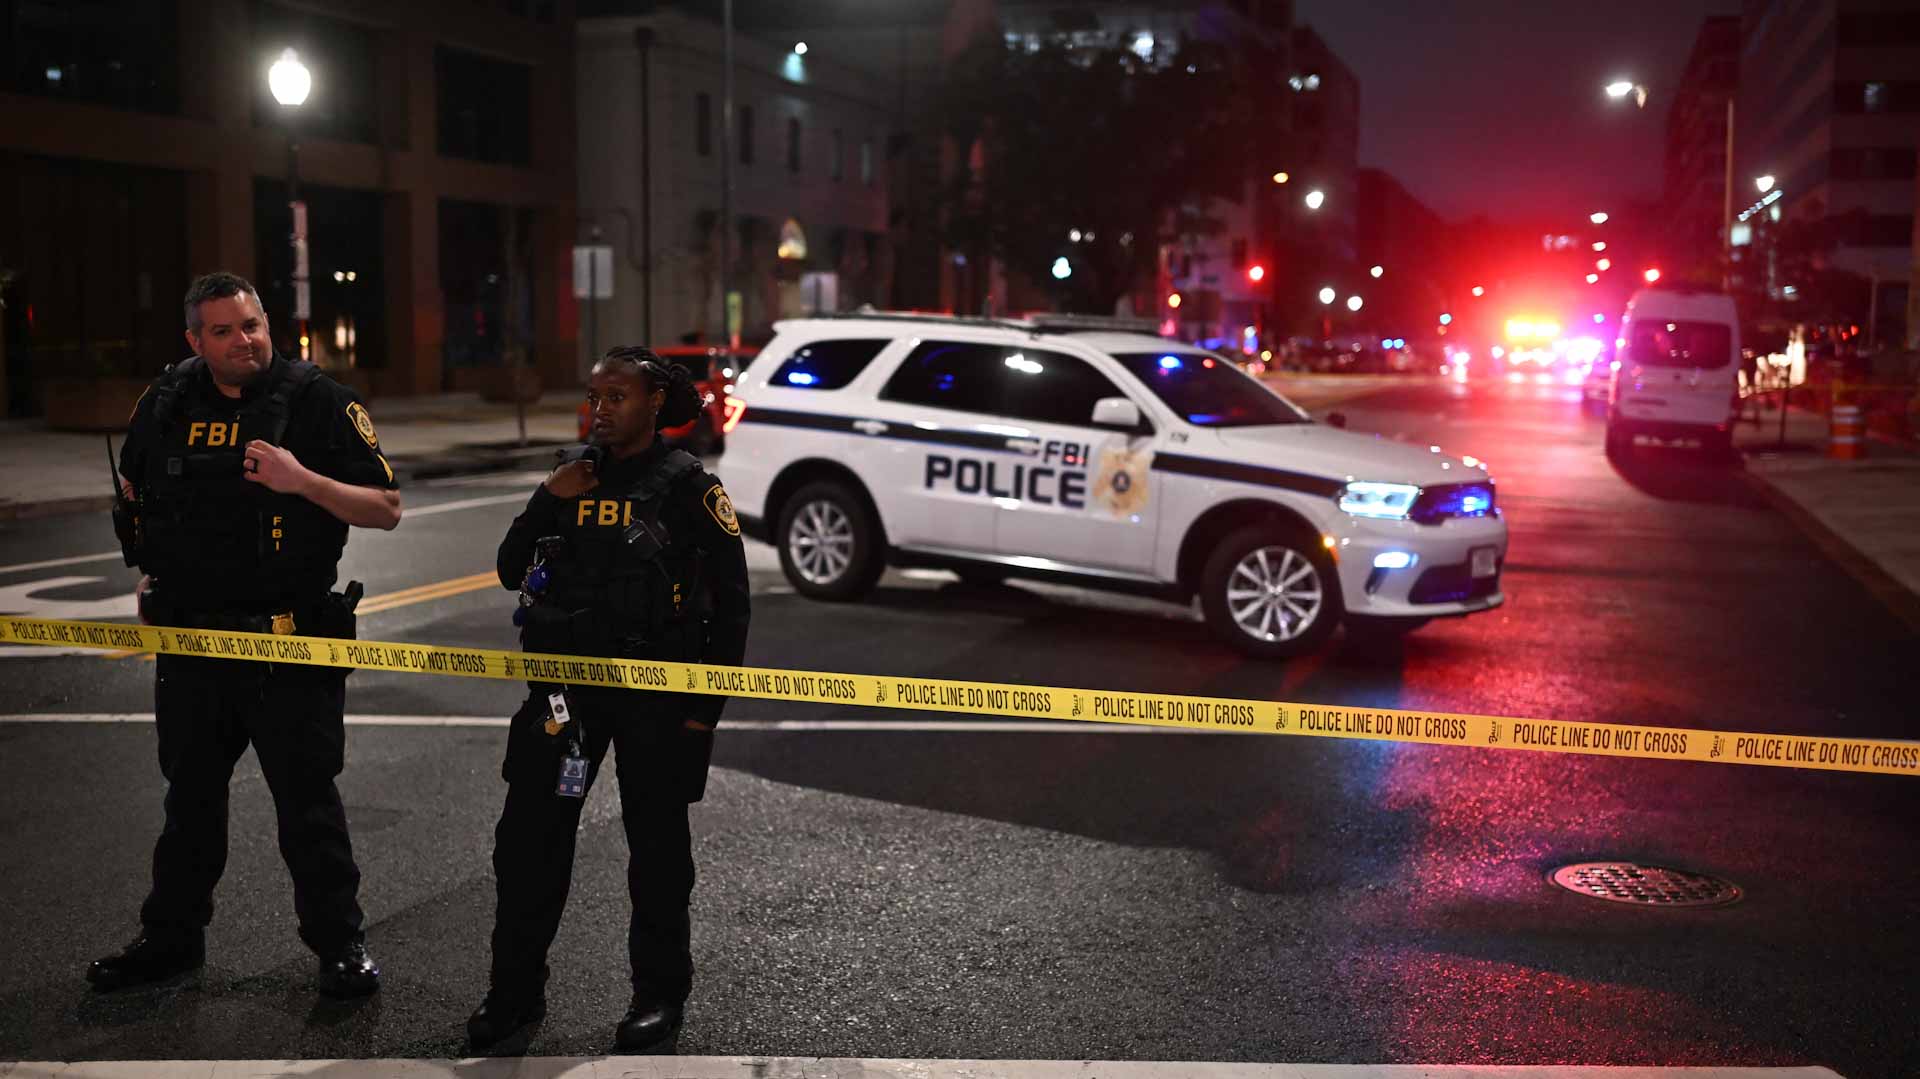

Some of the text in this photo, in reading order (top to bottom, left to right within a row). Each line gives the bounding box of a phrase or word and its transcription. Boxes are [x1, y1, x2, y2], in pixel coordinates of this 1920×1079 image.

[187, 422, 239, 446] FBI
[1043, 440, 1089, 468] FBI
[925, 455, 1087, 509] POLICE
[577, 500, 632, 526] FBI
[12, 622, 48, 640] POLICE
[50, 625, 67, 641] LINE
[71, 626, 86, 642] DO
[88, 628, 106, 645] NOT
[109, 629, 143, 648] CROSS
[214, 637, 236, 656] LINE
[238, 639, 253, 656] DO
[254, 640, 274, 657] NOT
[279, 642, 312, 660] CROSS
[347, 646, 383, 666] POLICE
[385, 649, 409, 668] LINE
[410, 650, 425, 670] DO
[428, 652, 449, 671] NOT
[451, 654, 486, 673] CROSS
[523, 658, 560, 679] POLICE
[564, 661, 587, 680] LINE
[589, 663, 604, 681] DO
[607, 664, 627, 683] NOT
[631, 666, 667, 687] CROSS
[706, 671, 856, 700] POLICE LINE DO NOT CROSS
[897, 684, 1051, 713] POLICE LINE DO NOT CROSS
[1095, 697, 1135, 718] POLICE
[1138, 699, 1164, 720] LINE
[1168, 701, 1183, 722] DO
[1187, 702, 1210, 723] NOT
[1214, 704, 1254, 725] CROSS
[1300, 710, 1342, 732] POLICE
[1345, 712, 1372, 733] LINE
[1376, 715, 1393, 735] DO
[1397, 716, 1422, 737] NOT
[1425, 718, 1466, 739] CROSS
[1513, 724, 1558, 745] POLICE
[1561, 726, 1590, 748] LINE
[1593, 728, 1610, 749] DO
[1614, 730, 1641, 751] NOT
[1644, 732, 1688, 754] CROSS
[1736, 738, 1783, 760] POLICE
[1786, 740, 1817, 762] LINE
[1819, 742, 1838, 764] DO
[1841, 744, 1870, 765] NOT
[1872, 746, 1919, 769] CROSS
